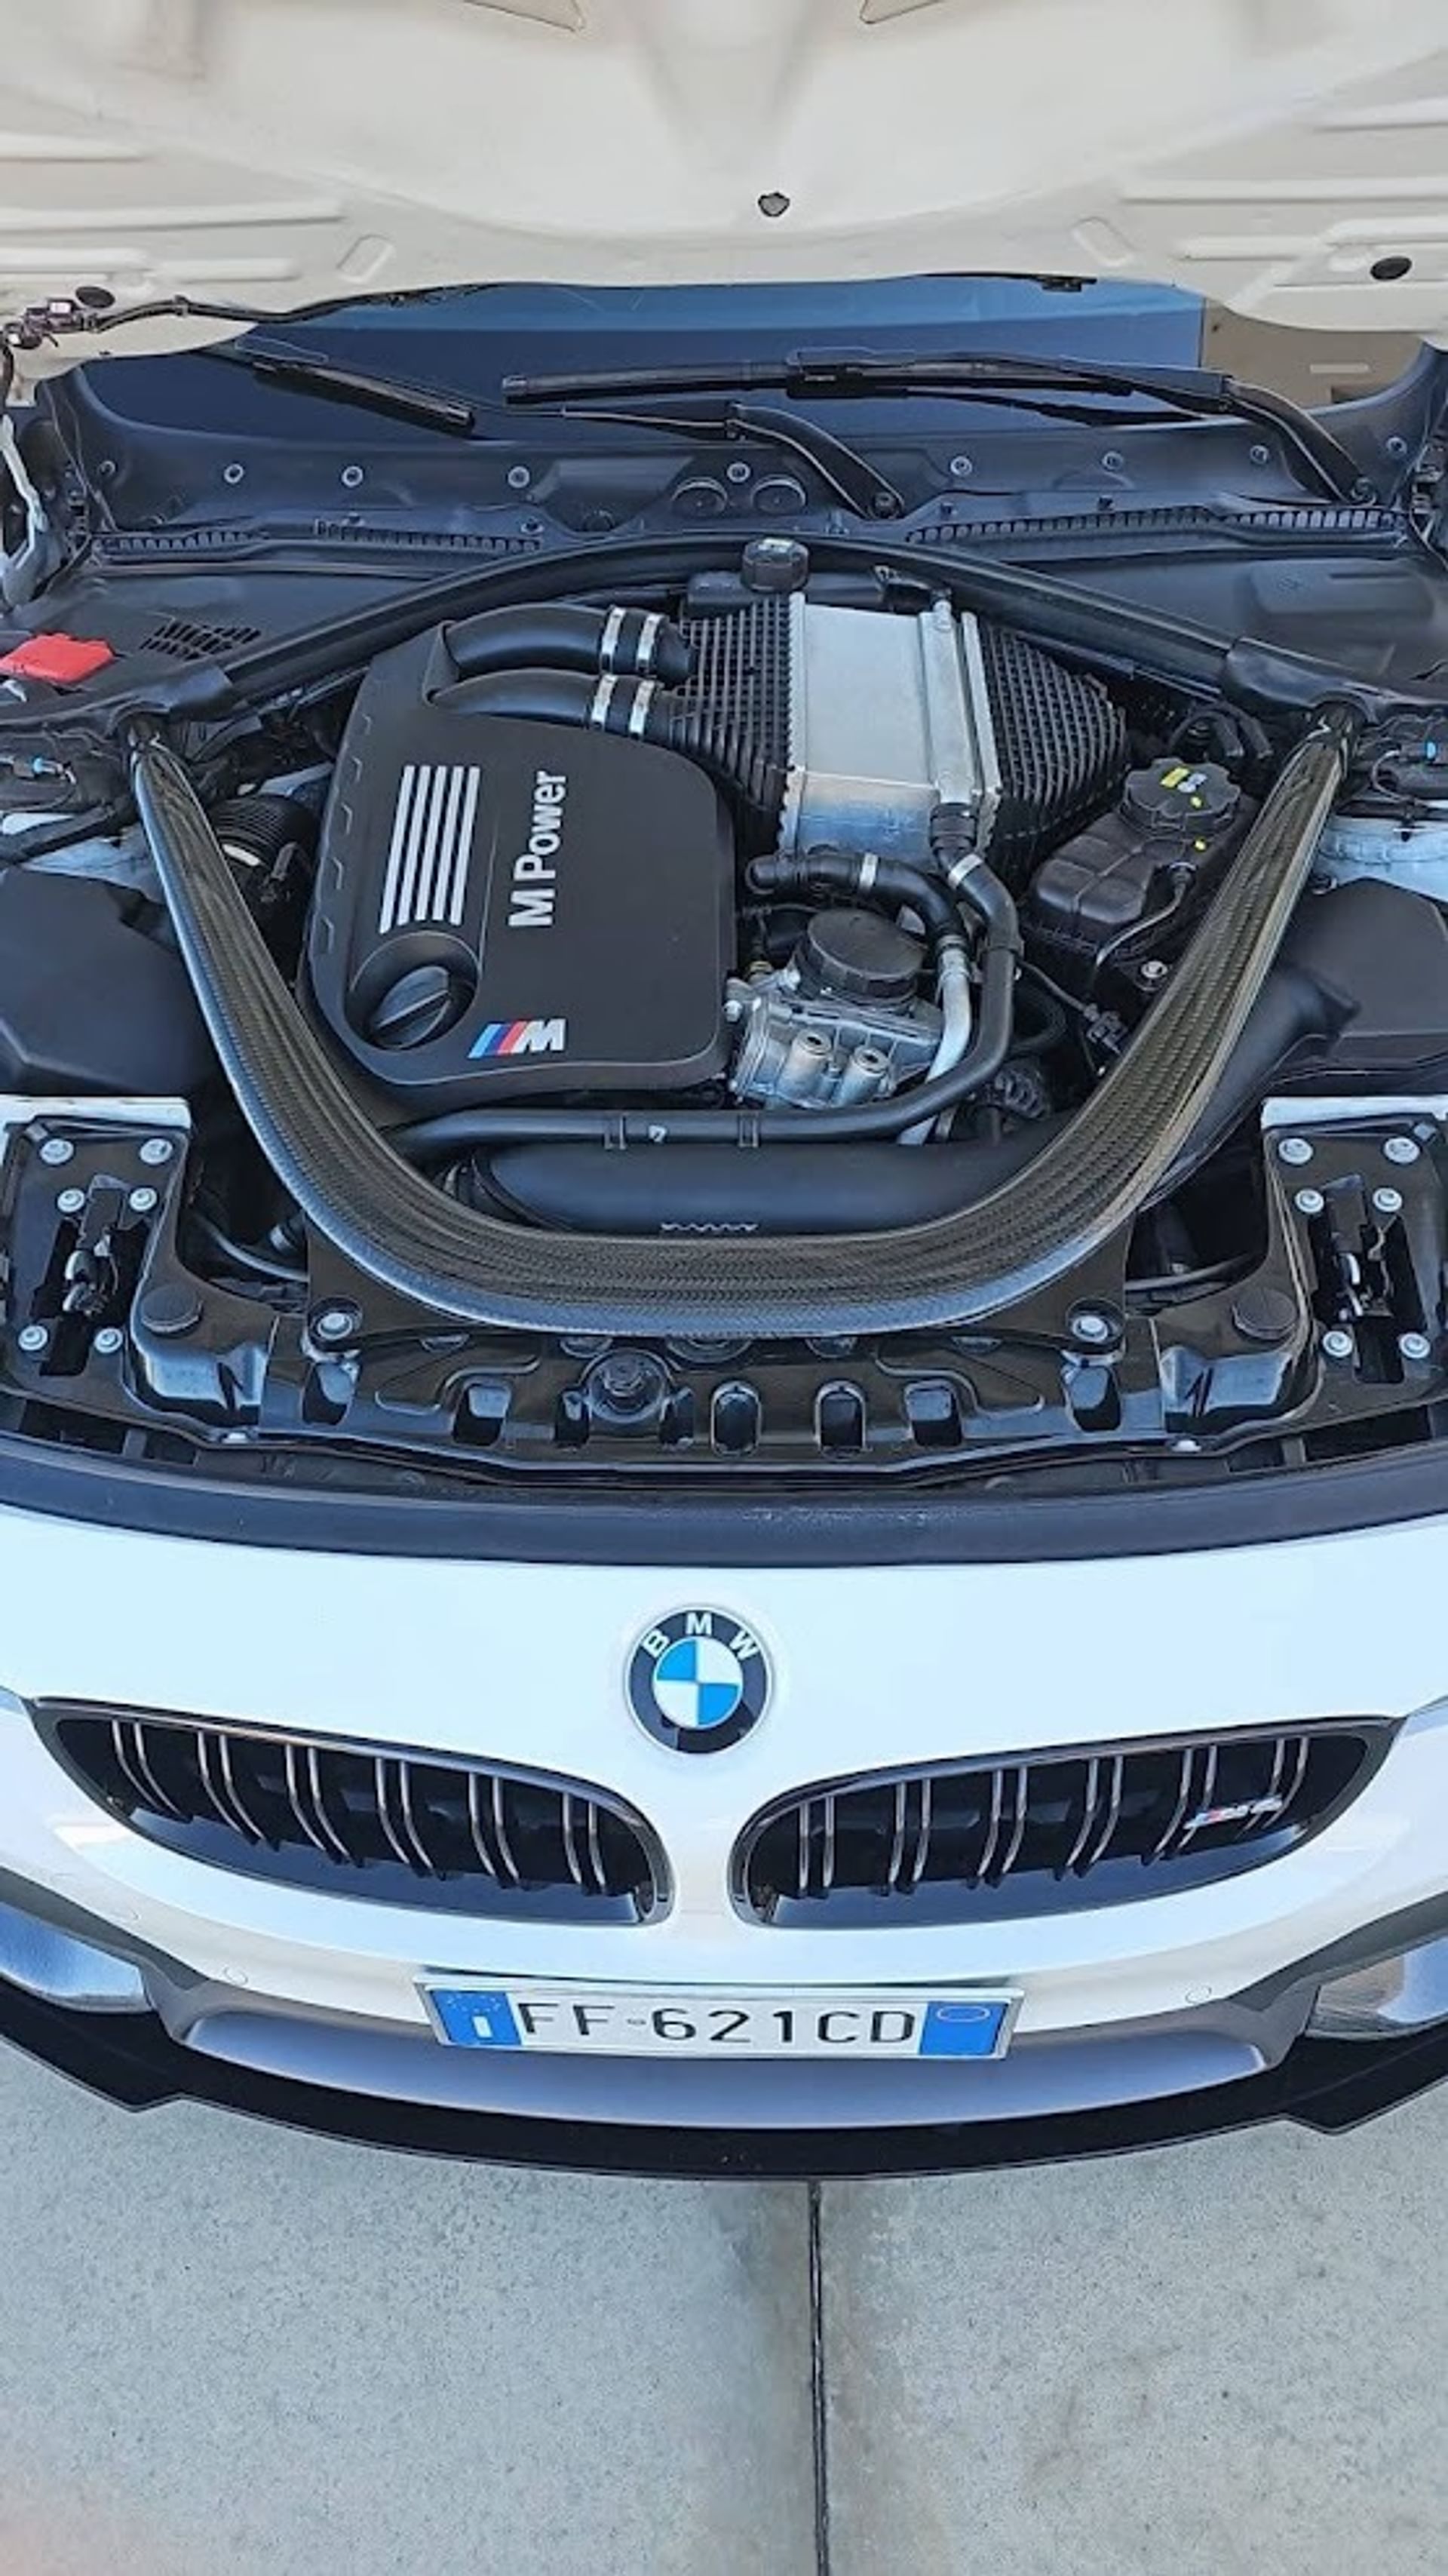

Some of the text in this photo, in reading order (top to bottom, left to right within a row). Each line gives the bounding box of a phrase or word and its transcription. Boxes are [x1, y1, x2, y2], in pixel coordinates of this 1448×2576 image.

[508, 769, 566, 926] M Power
[641, 1612, 759, 1660] BMW
